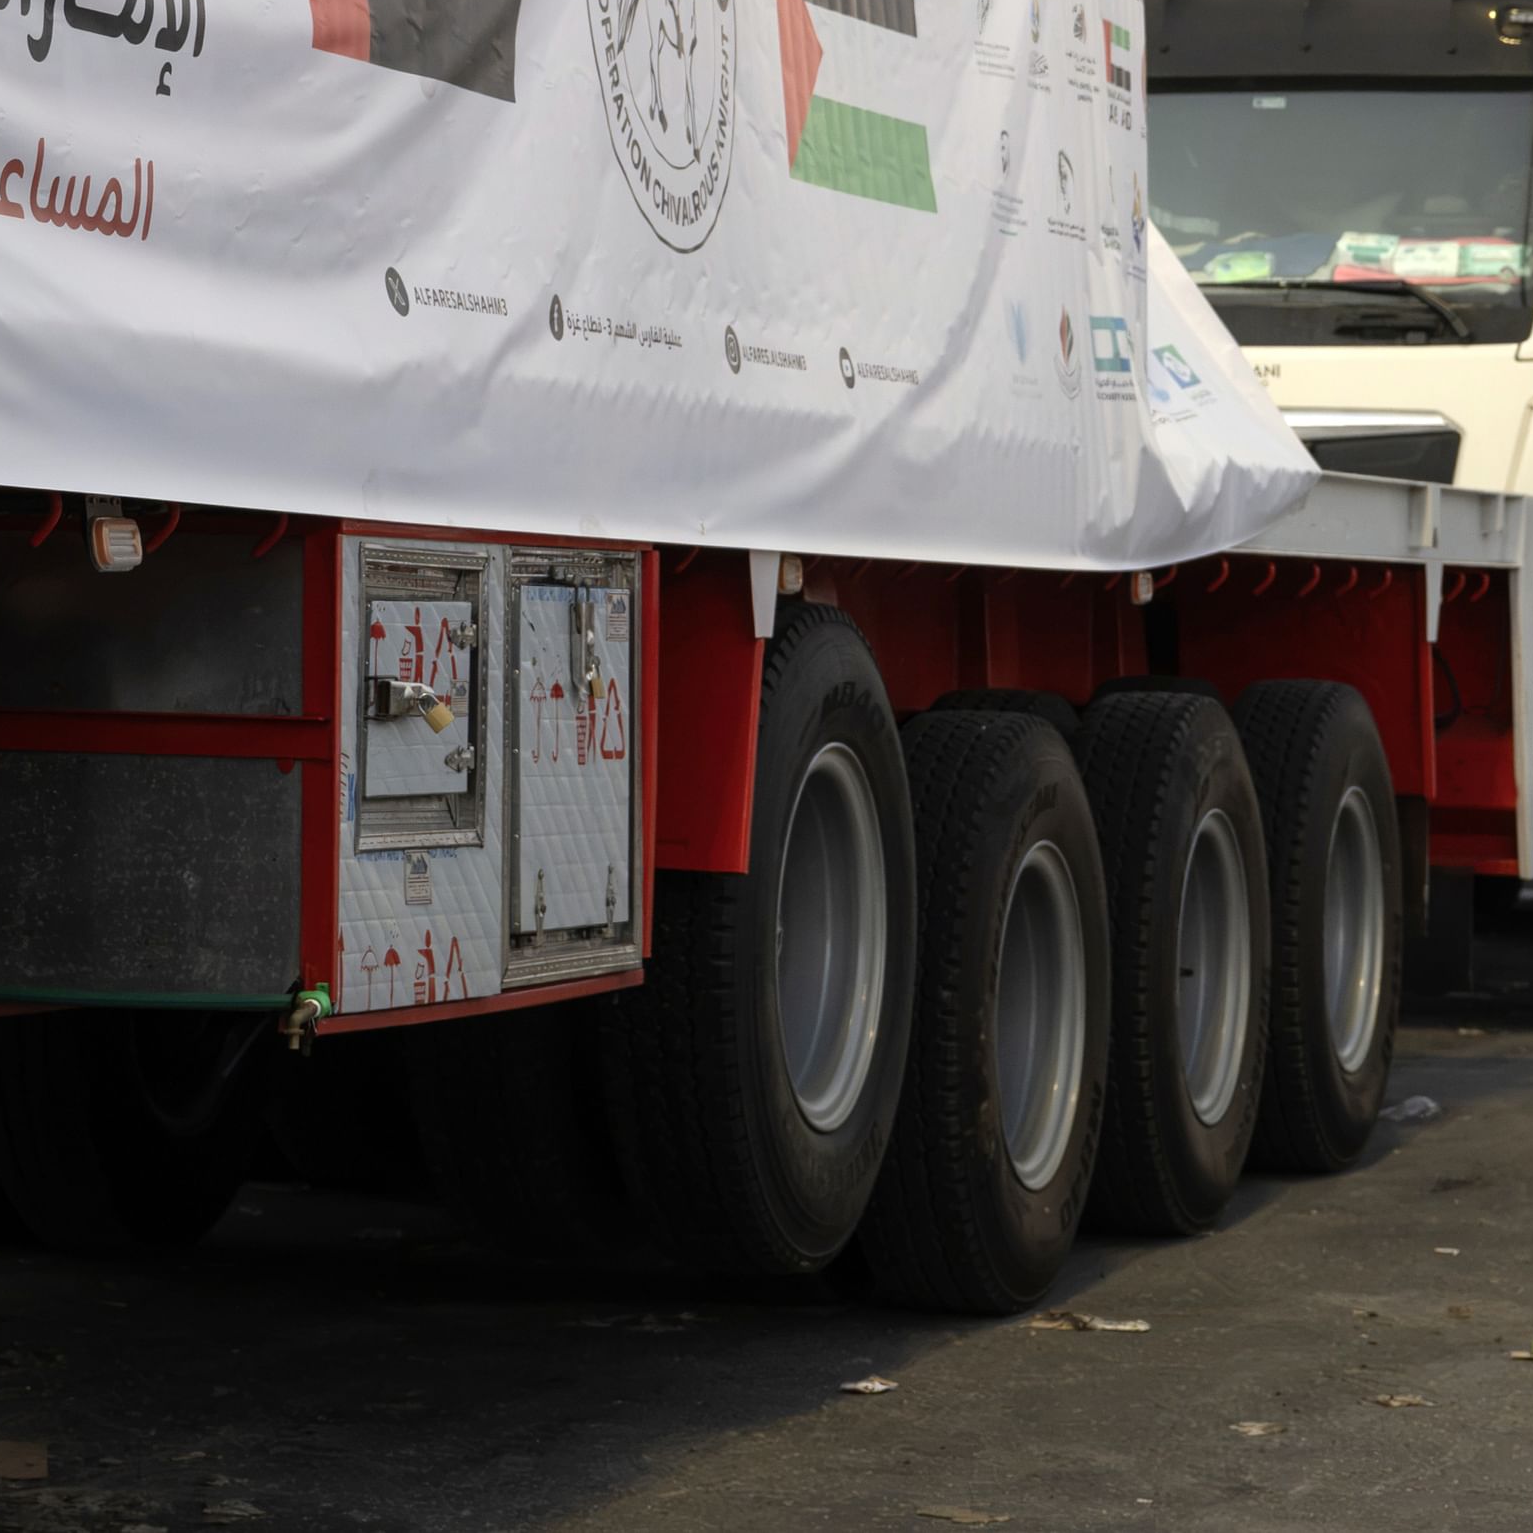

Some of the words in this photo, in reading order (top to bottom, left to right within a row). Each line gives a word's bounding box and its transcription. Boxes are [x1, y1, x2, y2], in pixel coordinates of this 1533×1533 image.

[652, 152, 721, 227] CHIVALROUS
[714, 24, 732, 160] KNIGHT
[413, 286, 508, 316] ALFARESALSHAHM3
